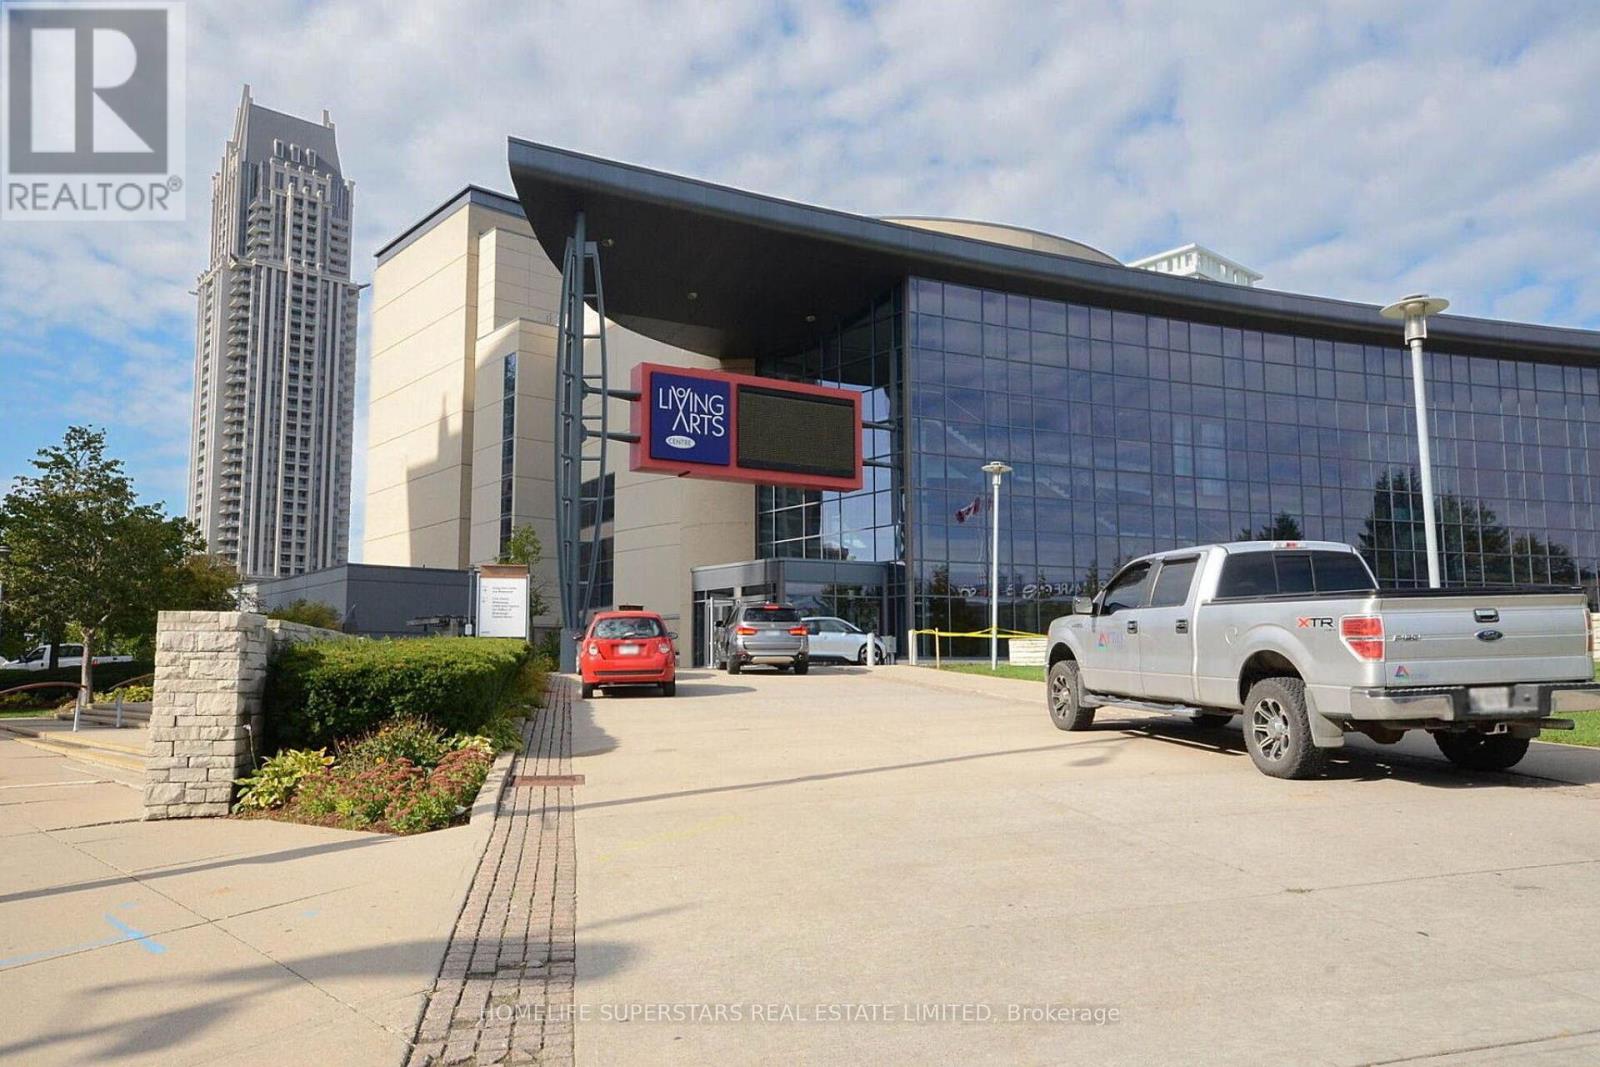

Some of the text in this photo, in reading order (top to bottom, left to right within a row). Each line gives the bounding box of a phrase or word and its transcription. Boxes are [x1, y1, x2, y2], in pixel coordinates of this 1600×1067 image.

[659, 386, 724, 416] LIVING
[672, 411, 724, 437] ARTS
[1298, 617, 1334, 628] XTR
